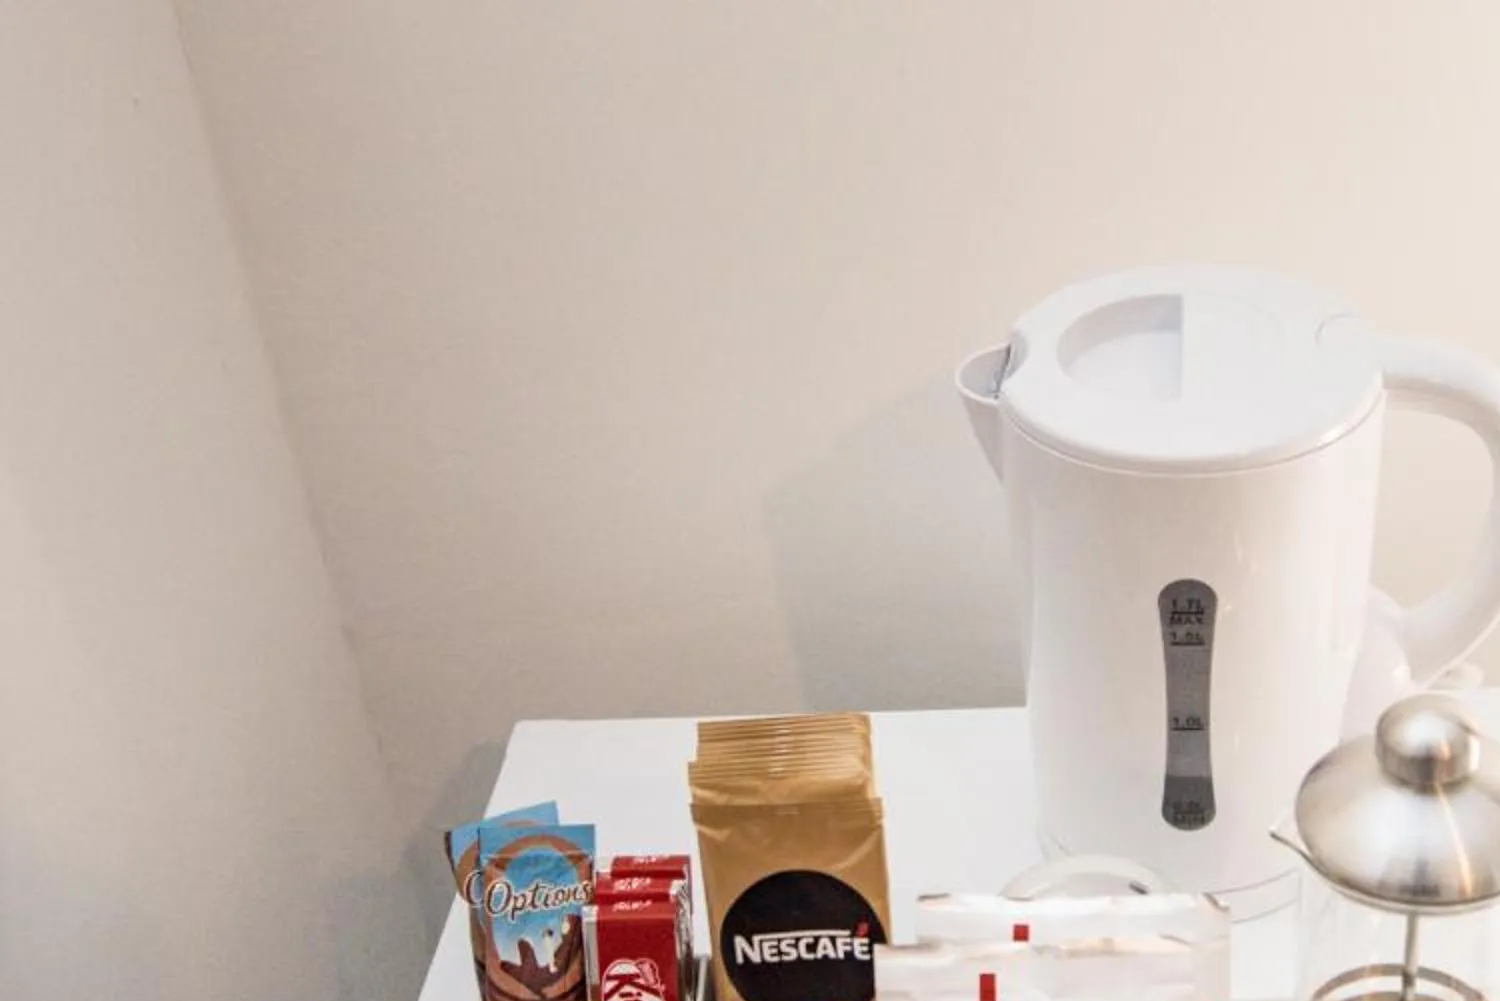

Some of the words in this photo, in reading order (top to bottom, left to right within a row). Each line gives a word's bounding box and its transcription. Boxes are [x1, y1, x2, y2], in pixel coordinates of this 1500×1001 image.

[1169, 614, 1203, 625] MAX
[484, 879, 596, 923] Options
[733, 920, 871, 965] NESCAFÉ
